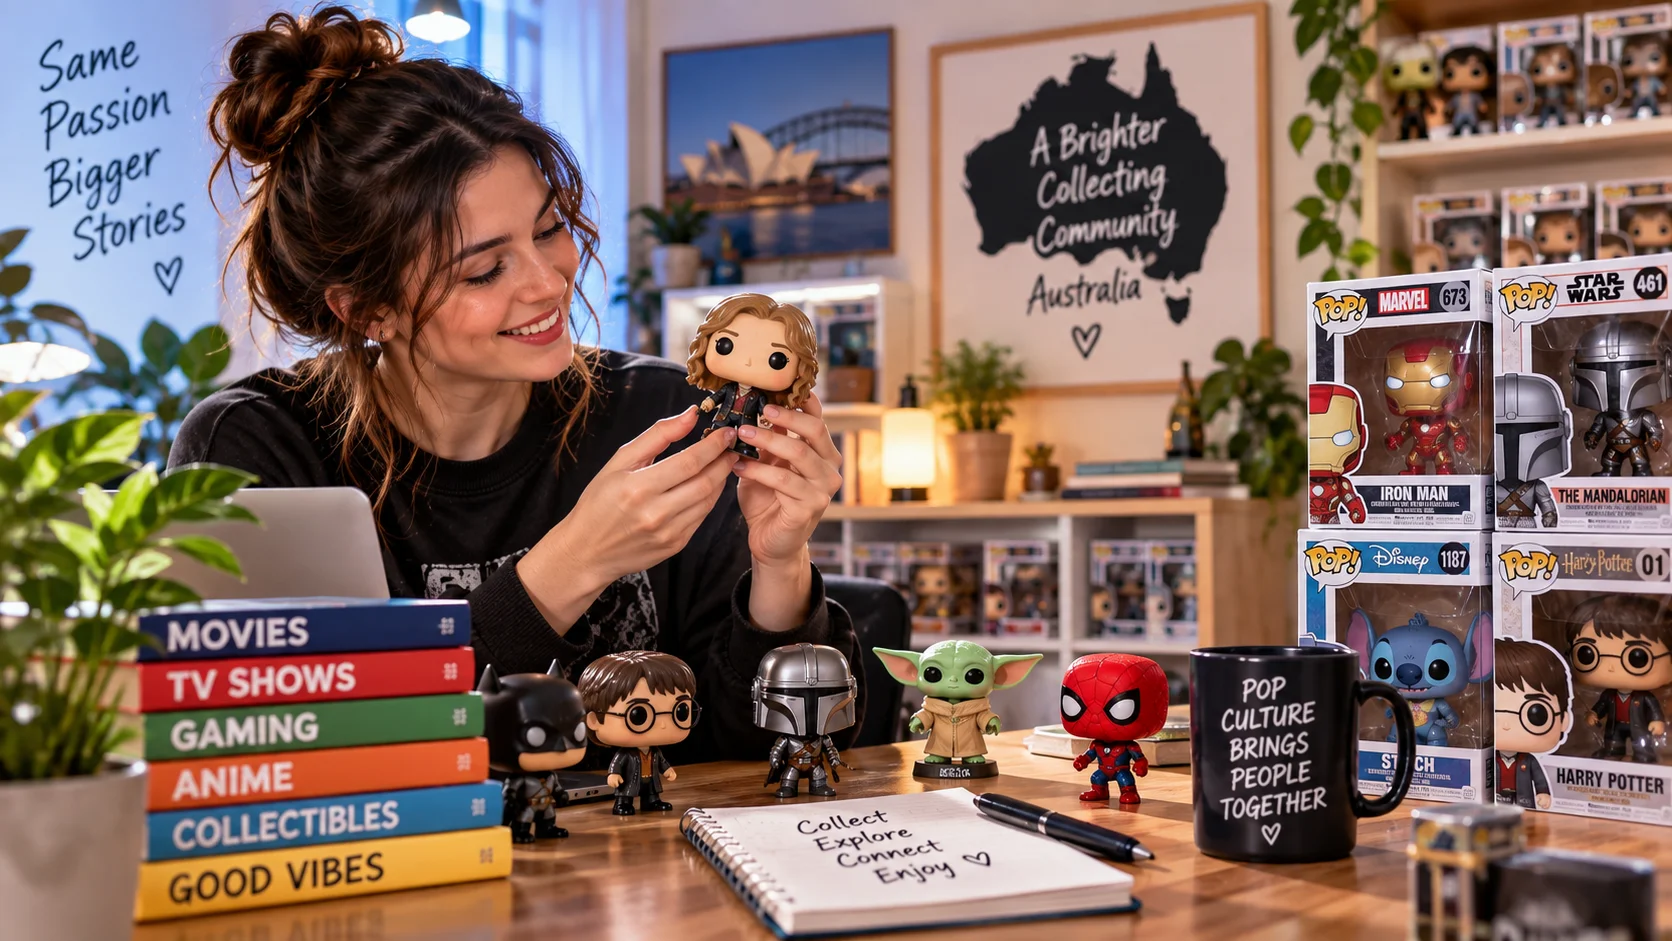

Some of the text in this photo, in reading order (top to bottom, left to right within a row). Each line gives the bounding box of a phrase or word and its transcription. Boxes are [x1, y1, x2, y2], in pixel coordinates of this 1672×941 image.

[39, 39, 139, 92] Same
[40, 87, 171, 151] Passion
[1030, 111, 1167, 167] A Brighter
[44, 147, 161, 210] Bigger
[1036, 159, 1168, 211] Collecting
[73, 201, 187, 260] Stories
[1035, 203, 1178, 254] Community
[1026, 267, 1141, 315] Australia
[1567, 286, 1624, 303] WARS
[1573, 272, 1625, 287] STAR
[1637, 273, 1663, 293] 461
[1378, 288, 1429, 312] MARVEL
[1443, 287, 1467, 306] 673
[1380, 485, 1449, 501] IRON MAN
[1558, 489, 1667, 504] THE MANDALORIAN
[1440, 549, 1467, 570] 1187
[1641, 552, 1664, 577] 01
[167, 617, 309, 652] MOVIES
[166, 662, 356, 701] TV SHOWS
[1242, 676, 1287, 703] POP
[170, 712, 319, 752] GAMING
[1221, 701, 1316, 733] CULTURE
[1229, 731, 1310, 762] BRINGS
[1230, 760, 1312, 791] PEOPLE
[1381, 753, 1435, 773] STCH
[172, 762, 293, 801] ANIME
[1556, 767, 1664, 795] HARRY POTTER
[1219, 787, 1328, 821] TOGETHER
[172, 800, 400, 850] COLLECTIBLES
[797, 810, 888, 836] Collect
[813, 826, 913, 852] Explore
[836, 839, 943, 869] Connect
[169, 852, 384, 906] GOOD VIBES
[874, 860, 956, 884] Enjoy
